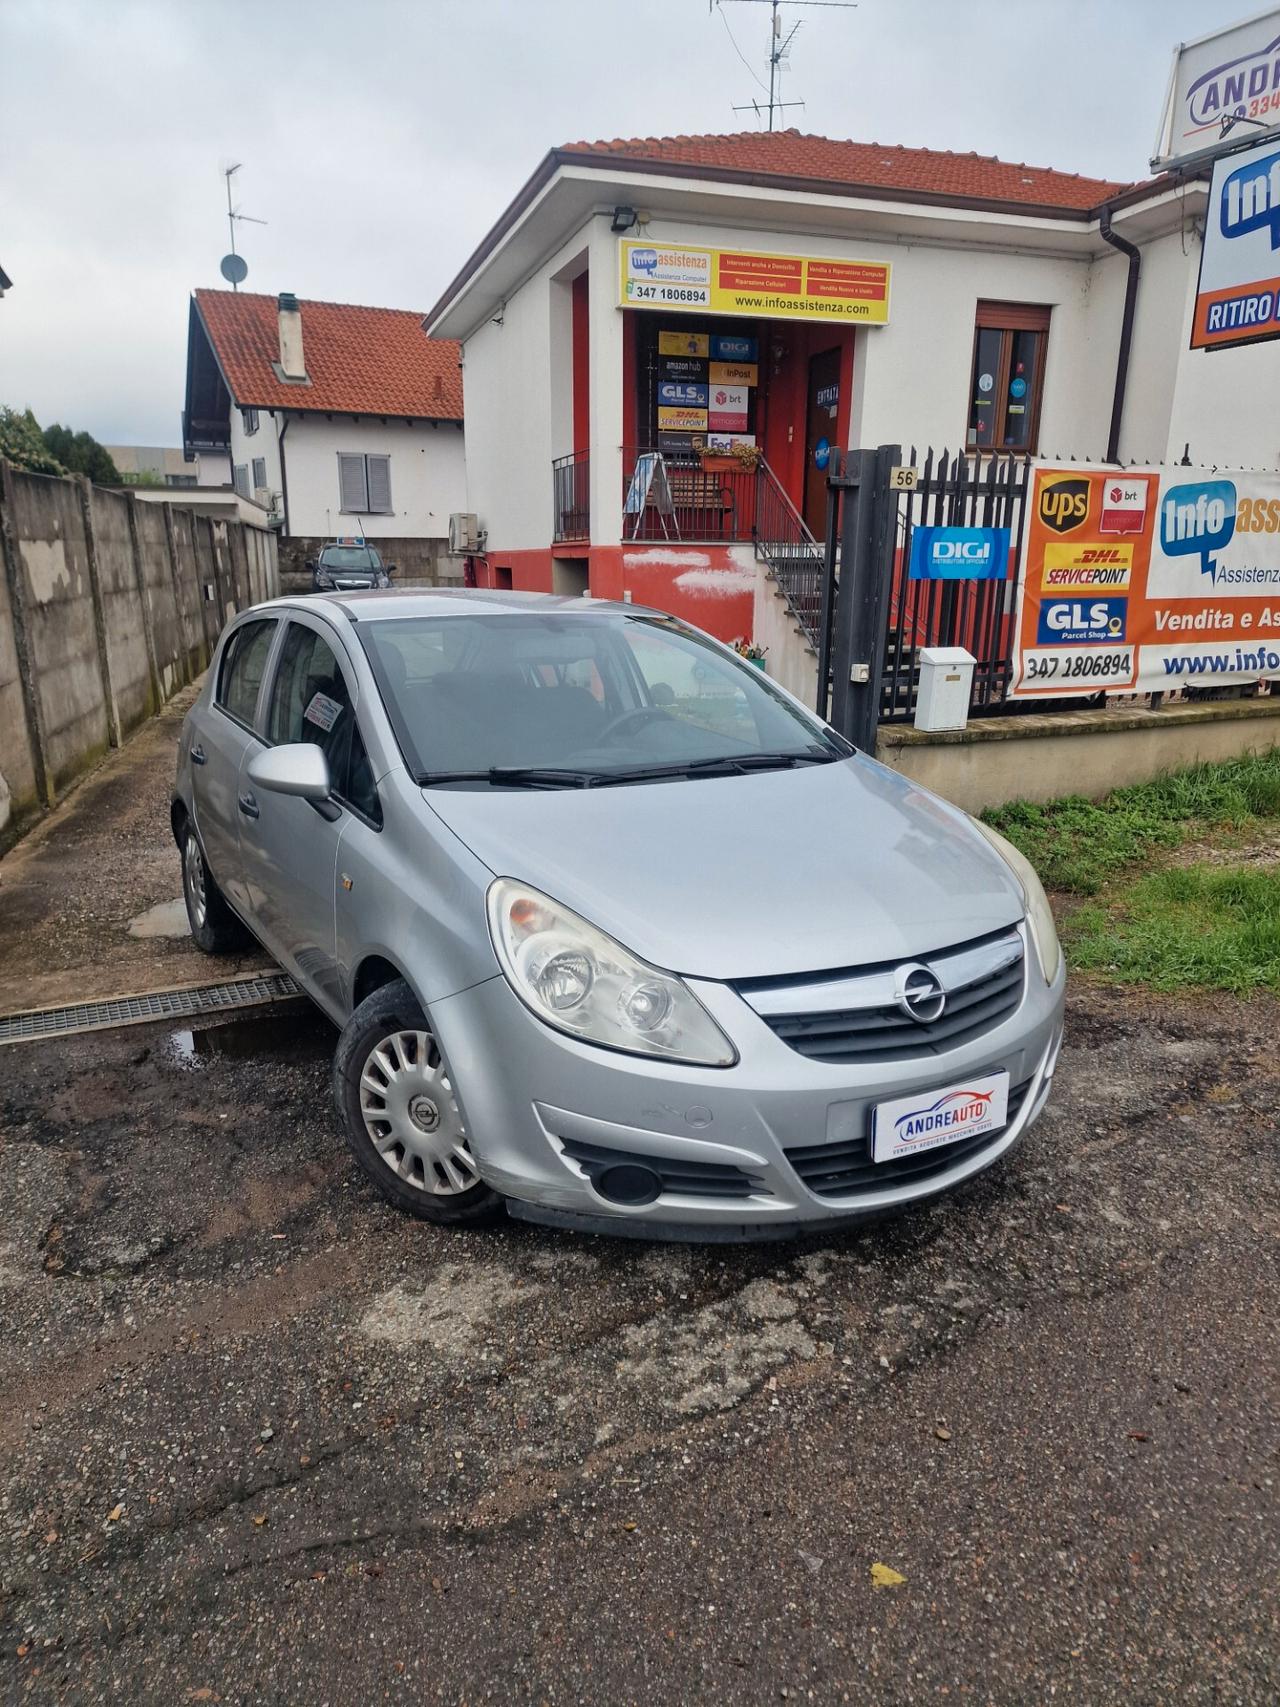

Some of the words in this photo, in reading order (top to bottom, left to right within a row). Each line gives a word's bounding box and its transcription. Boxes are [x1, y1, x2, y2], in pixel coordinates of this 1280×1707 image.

[658, 252, 707, 269] assistenza
[809, 265, 828, 274] Vendita
[636, 286, 657, 299] 347
[660, 288, 706, 302] 1806894
[735, 296, 870, 315] www.infoassistenza.com
[1209, 294, 1272, 331] RITIRO
[719, 341, 749, 352] DIGI
[666, 360, 688, 371] amazon
[688, 361, 702, 372] hub
[726, 368, 751, 379] InPost
[661, 385, 697, 399] GLS
[729, 394, 742, 404] brt
[660, 418, 705, 427] SERVICEPOINT
[675, 410, 701, 419] DHL
[896, 470, 913, 486] 56
[1124, 490, 1137, 501] brt
[1042, 490, 1087, 526] ups
[1164, 493, 1226, 543] Info
[932, 541, 991, 559] DIGI
[1080, 549, 1120, 564] DHL
[1046, 568, 1128, 584] SERVICEPOINT
[1217, 564, 1280, 584] Assistenz
[1046, 603, 1109, 630] GLS
[1154, 608, 1234, 632] Vendita
[1240, 612, 1253, 629] e
[1061, 632, 1087, 640] Parcel
[1088, 631, 1107, 640] Shop
[1027, 656, 1059, 680] 347
[1061, 653, 1132, 678] 1806894
[1163, 647, 1280, 675] www.info
[905, 1102, 983, 1137] ANDREAUTO
[892, 1145, 917, 1155] VENDITA
